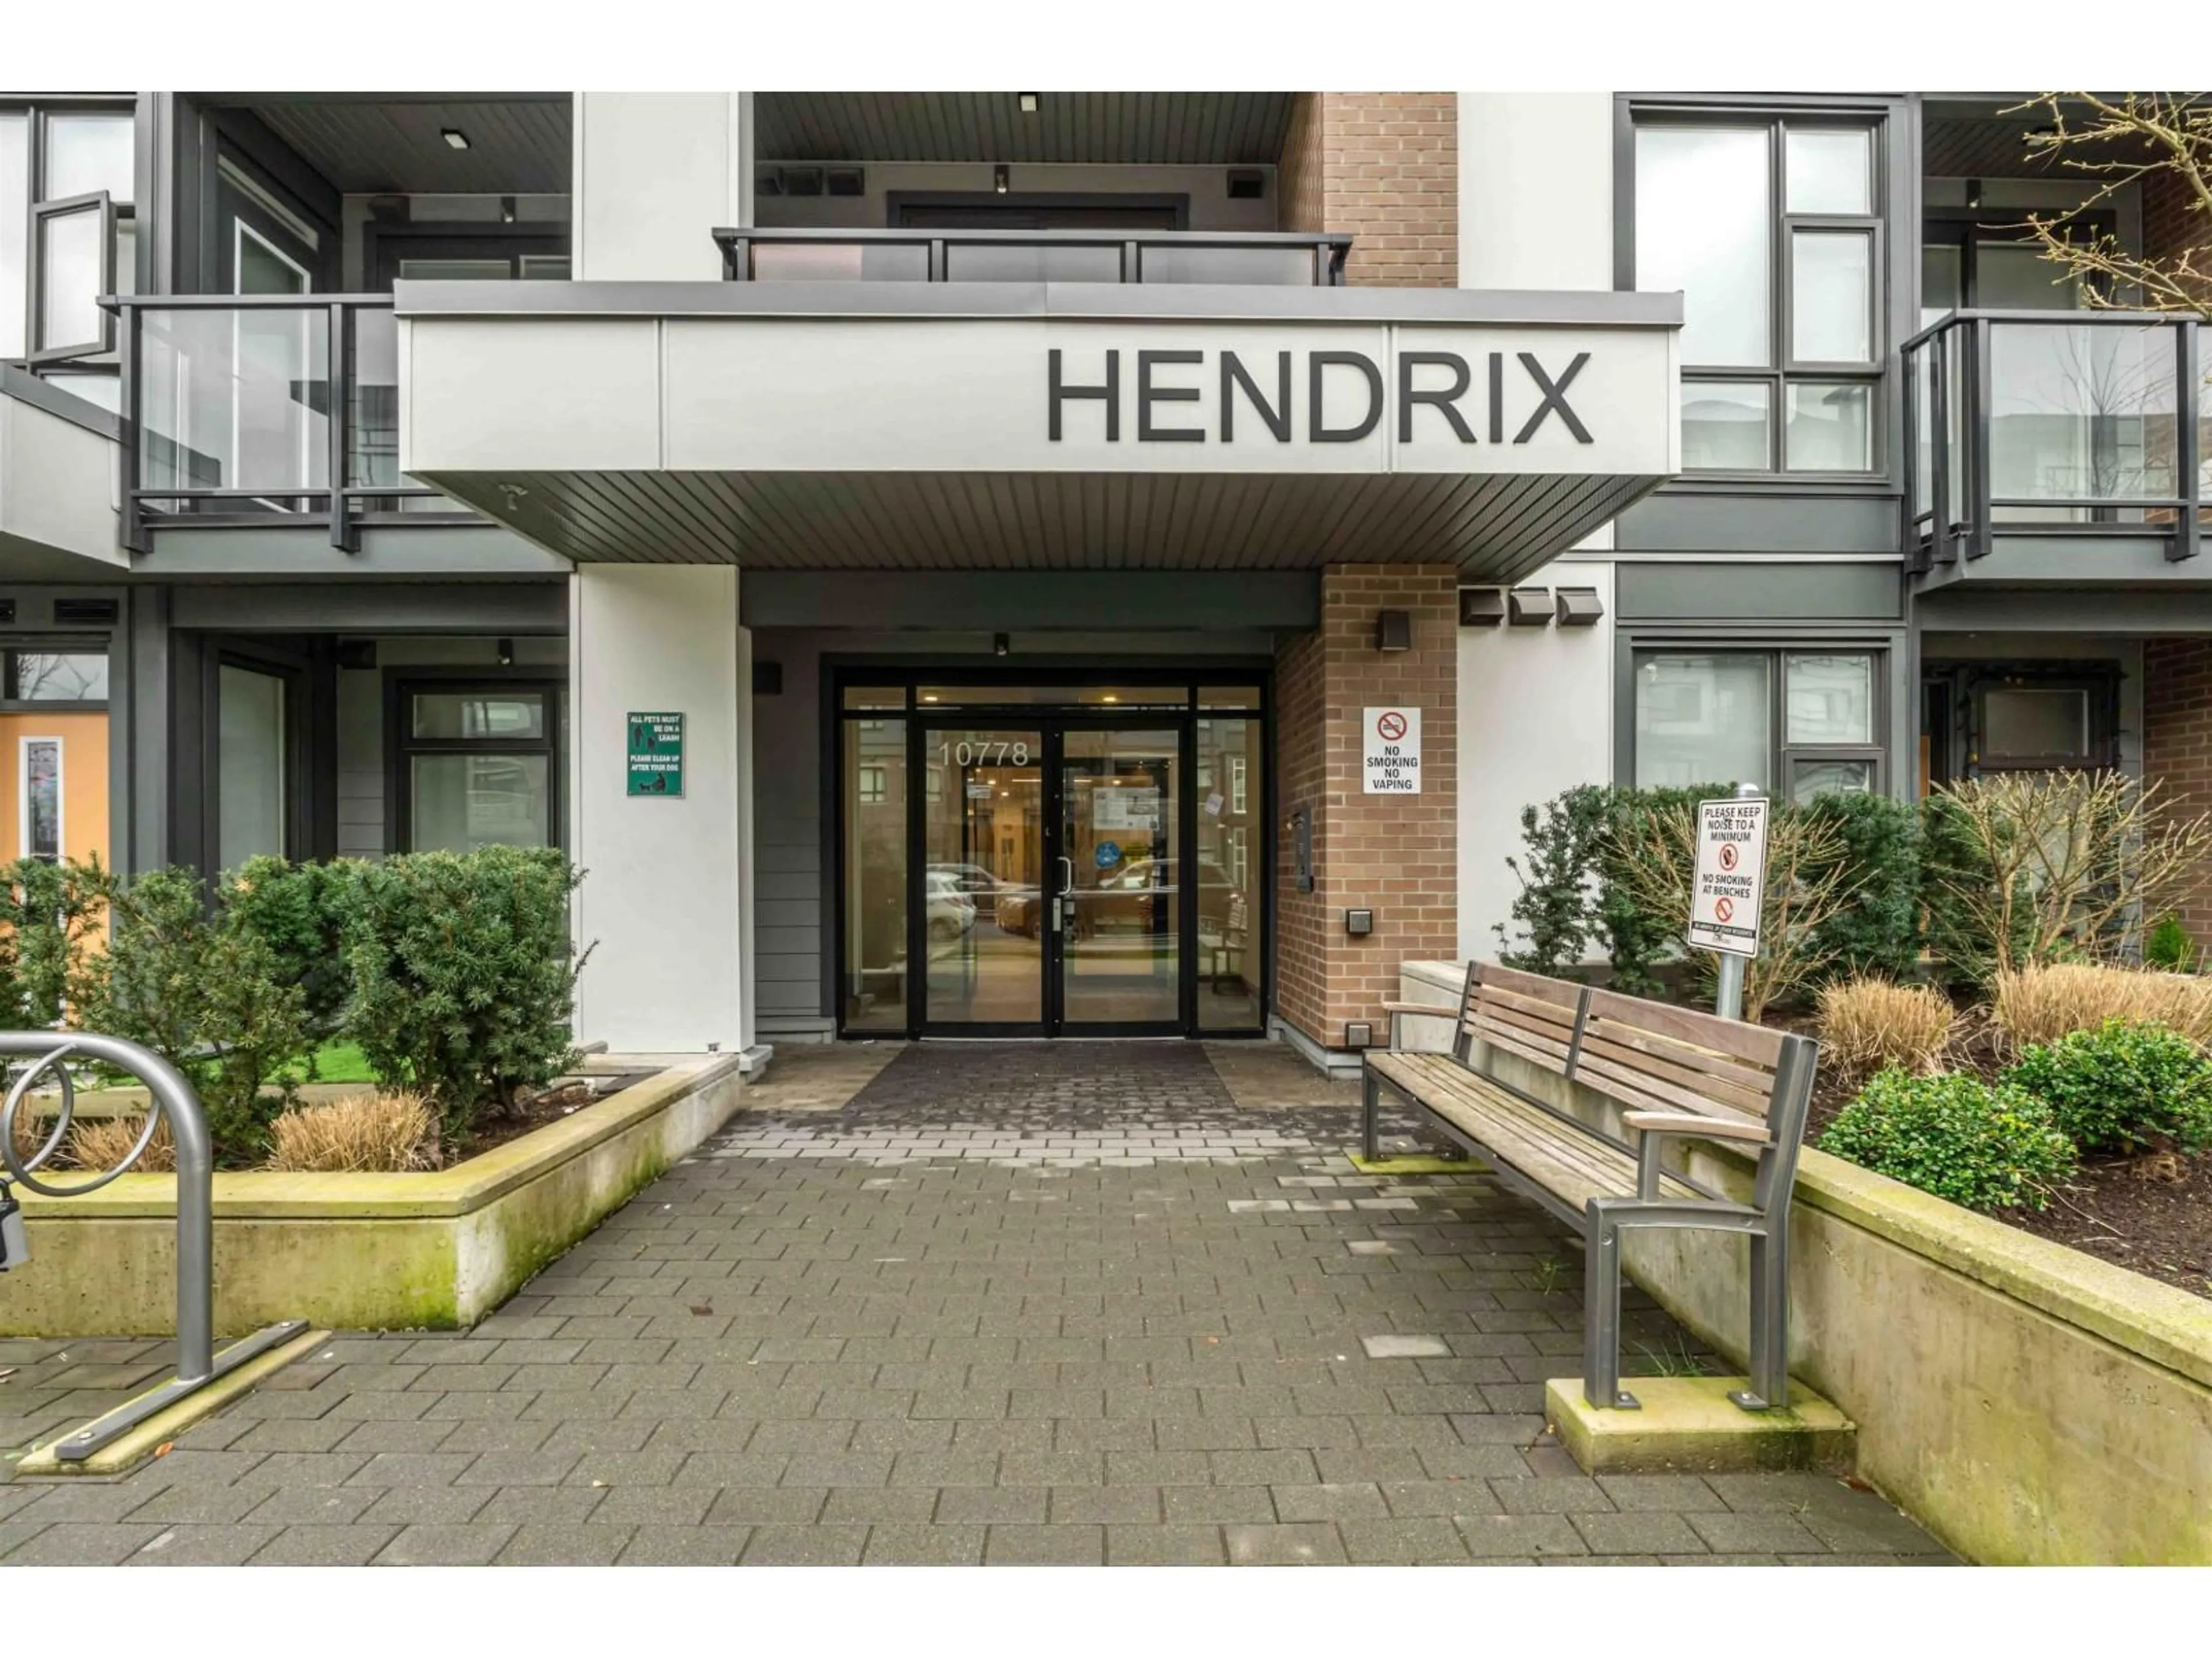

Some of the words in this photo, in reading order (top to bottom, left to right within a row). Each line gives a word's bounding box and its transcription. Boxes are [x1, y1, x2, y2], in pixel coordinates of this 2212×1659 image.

[1048, 349, 1594, 444] HENDRIX
[939, 742, 1028, 766] 10778
[1385, 746, 1400, 756] NO
[1367, 757, 1418, 767] SMOKING
[1385, 768, 1400, 778] NO
[1373, 779, 1412, 789] VAPING
[1705, 807, 1735, 818] PLEASE
[1737, 807, 1761, 817] KEEP
[1707, 819, 1733, 830] NOISE
[1735, 819, 1747, 830] TO
[1748, 819, 1755, 830] A
[1710, 832, 1751, 842] MINIMUM
[1702, 873, 1714, 883] NO
[1715, 874, 1753, 887] SMOKING
[1703, 884, 1713, 893] AT
[1714, 885, 1750, 899] BENCHES
